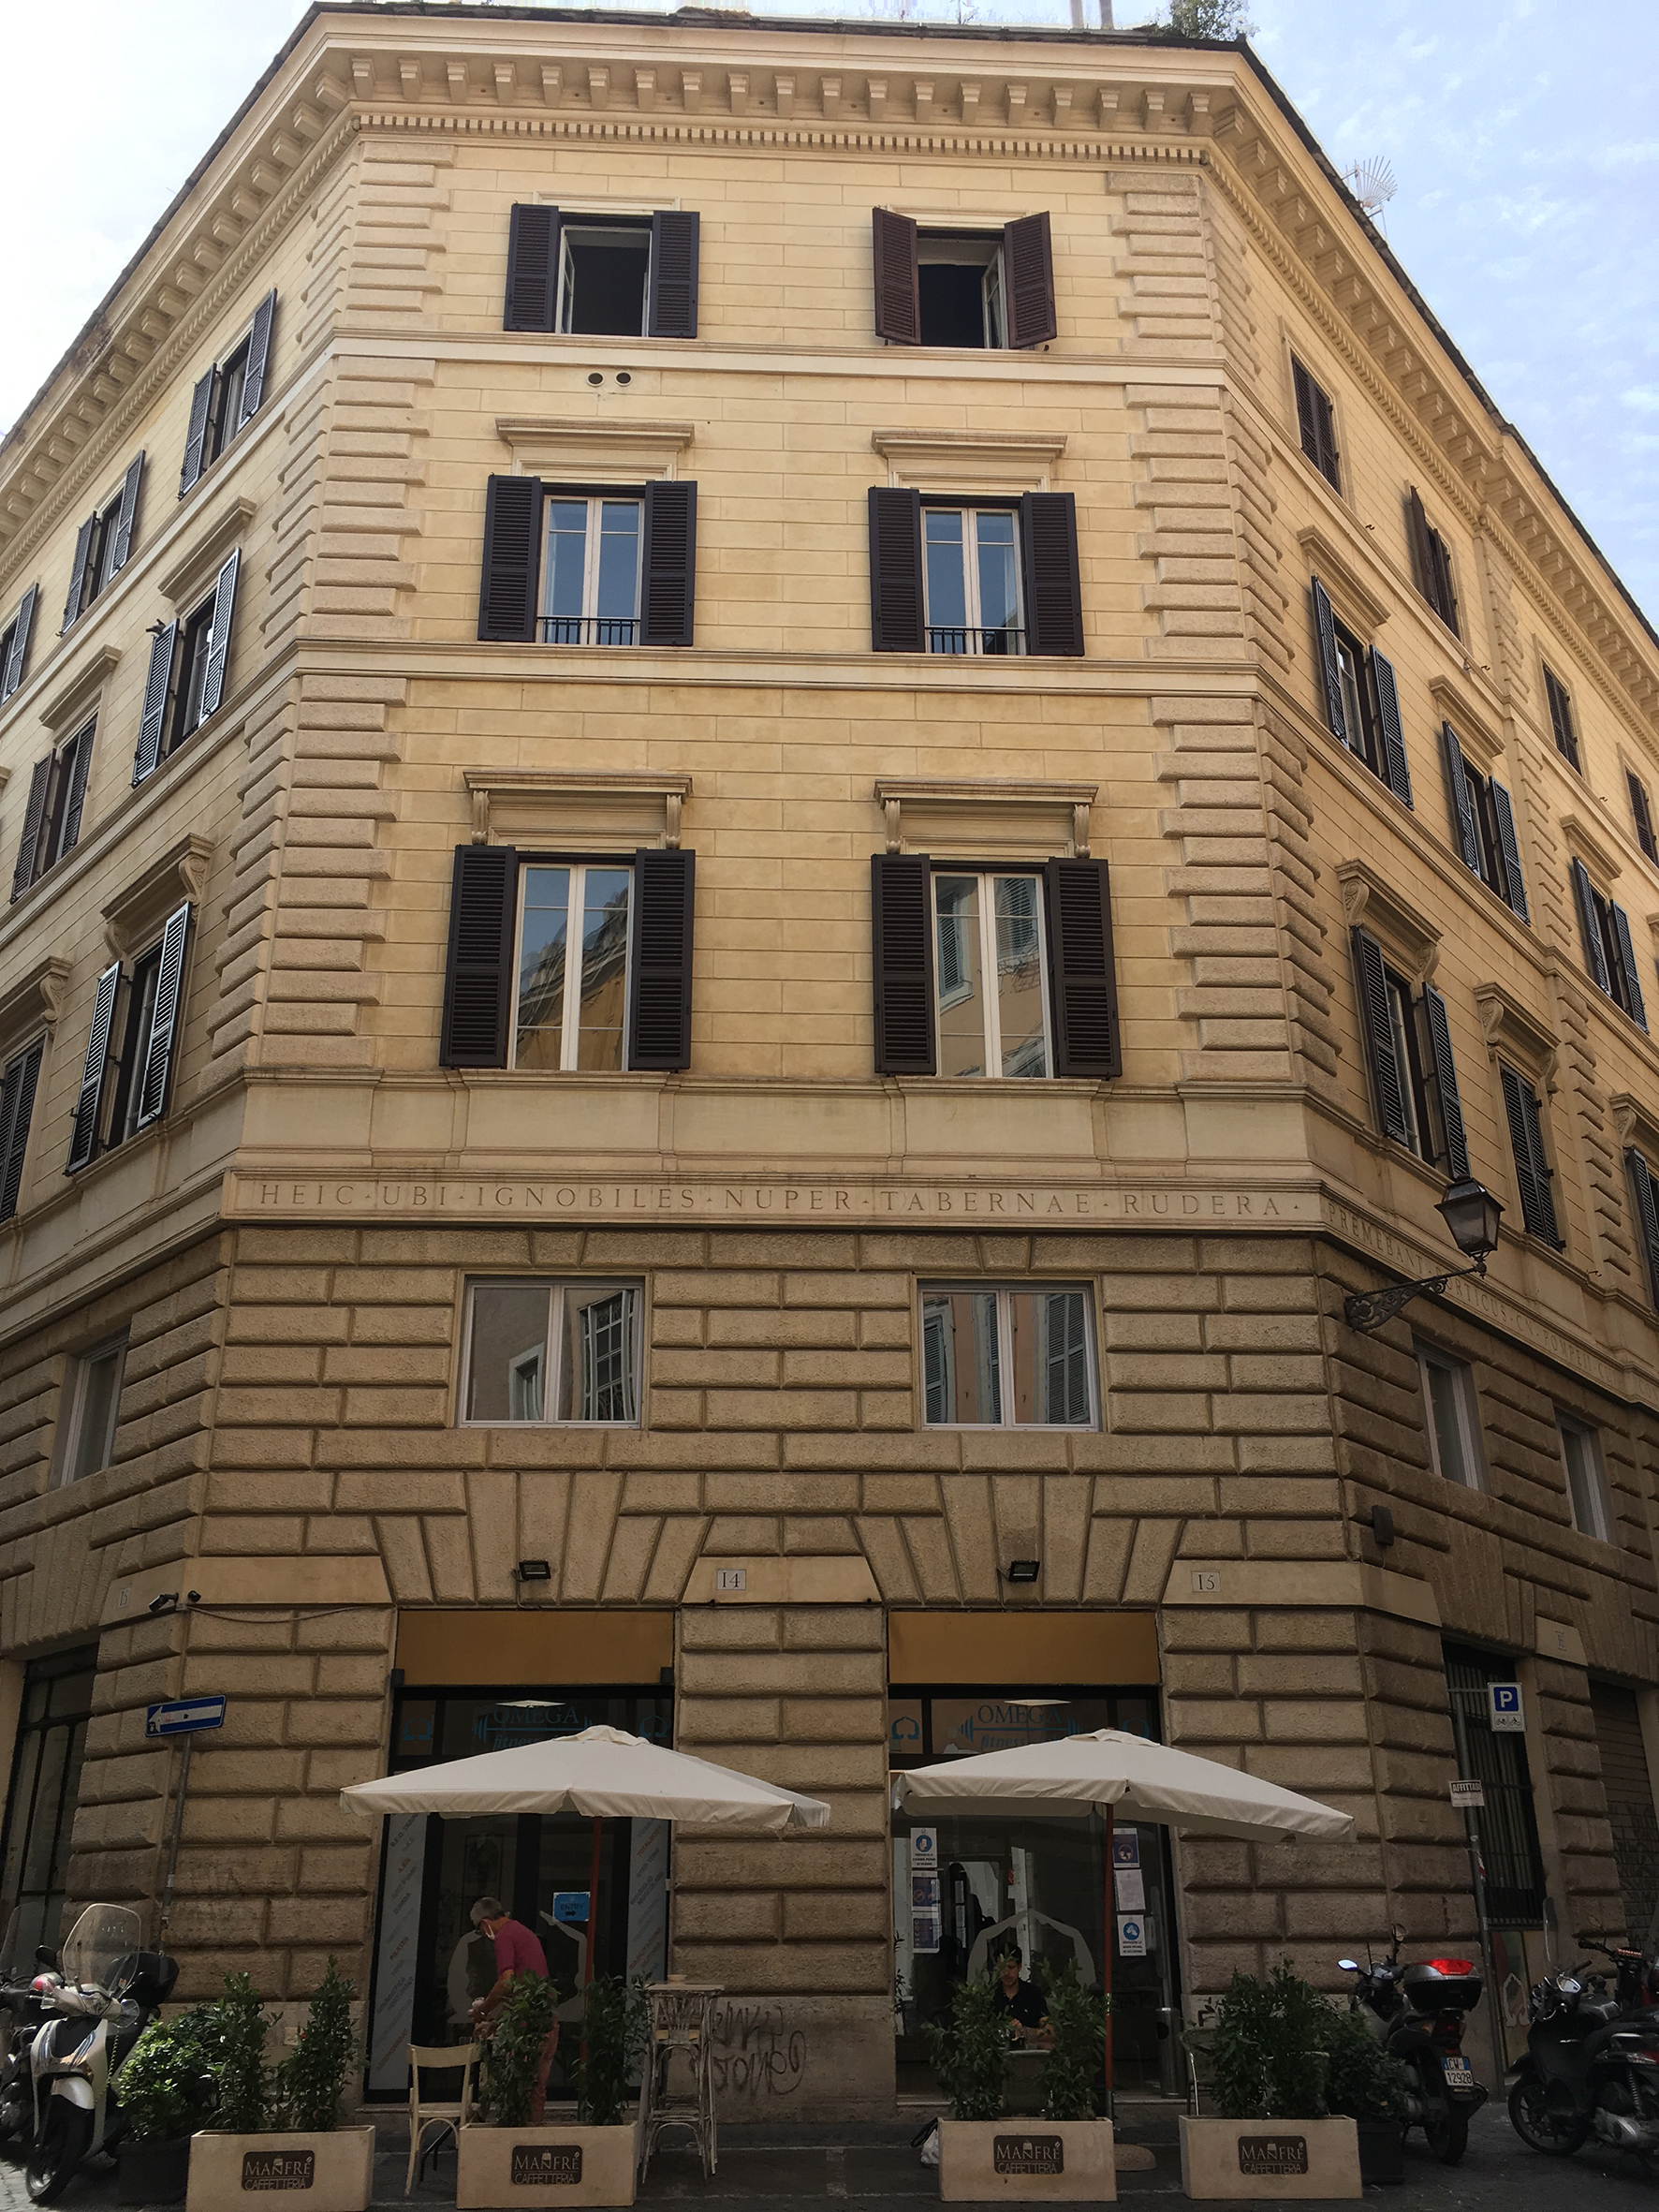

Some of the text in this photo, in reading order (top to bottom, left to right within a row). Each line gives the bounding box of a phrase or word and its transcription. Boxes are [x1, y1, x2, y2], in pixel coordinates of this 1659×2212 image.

[259, 1185, 1281, 1216] HEIC UBI IGNOBILES NUPER TABERNAE RUDERA
[1328, 1202, 1423, 1275] PREMEBANT
[722, 1571, 741, 1588] 14
[1198, 1574, 1215, 1590] 15
[1499, 1690, 1513, 1708] P
[492, 1705, 580, 1724] OMEGA
[977, 1704, 1062, 1724] OMEGA
[1446, 2072, 1472, 2085] 12928
[997, 2162, 1058, 2175] CAFFETTERIA
[1243, 2163, 1302, 2175] CAFFETTERIA
[244, 2178, 306, 2190] CAFFETTERIA
[515, 2173, 575, 2185] CAFFETTERIA
